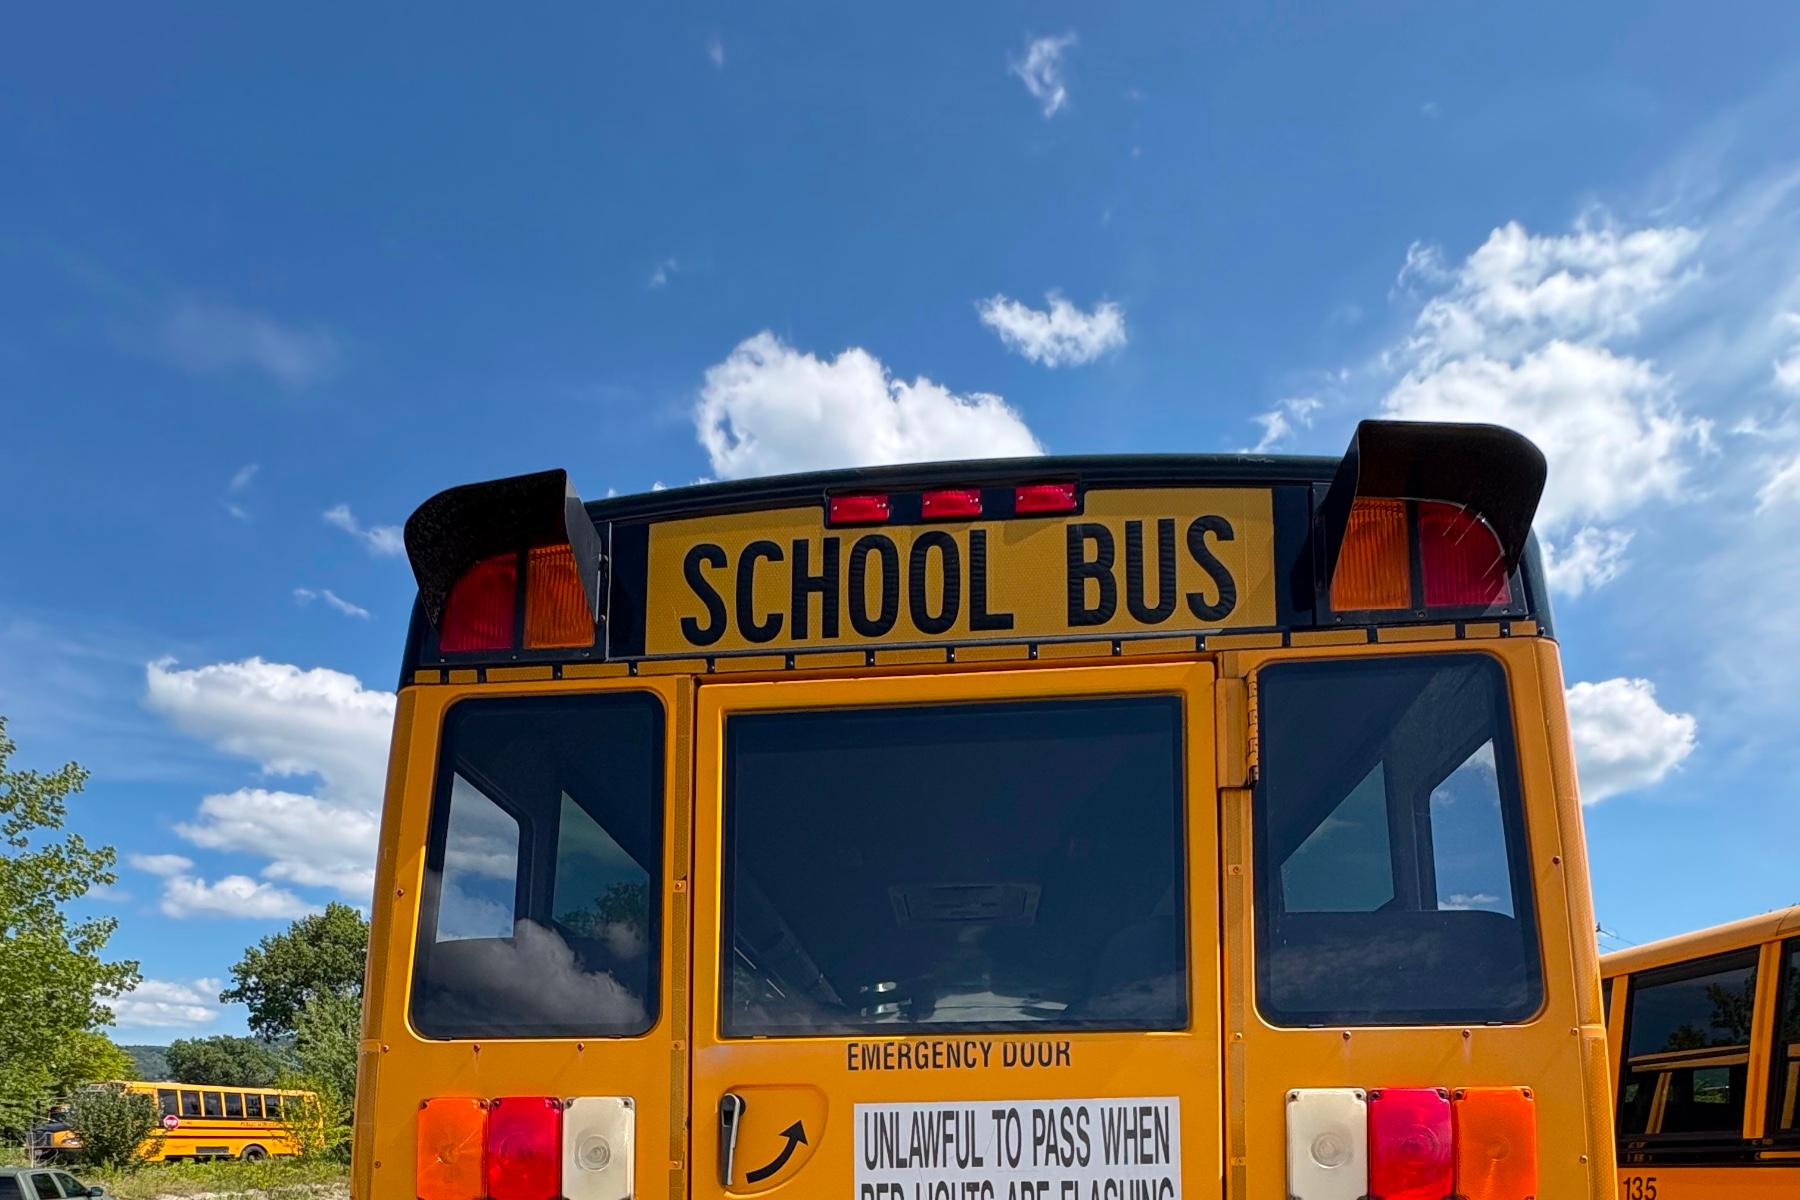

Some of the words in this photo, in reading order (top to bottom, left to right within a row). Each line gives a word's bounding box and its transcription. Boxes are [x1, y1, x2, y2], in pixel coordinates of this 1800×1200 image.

[681, 529, 1014, 646] SCHOOL
[1066, 515, 1237, 627] BUS
[847, 1041, 992, 1071] EMERGENCY
[1002, 1040, 1071, 1068] DOOR
[863, 1109, 983, 1170] UNLAWFUL
[992, 1108, 1021, 1169] TO
[1032, 1106, 1090, 1168] PASS
[1100, 1105, 1170, 1165] WHEN
